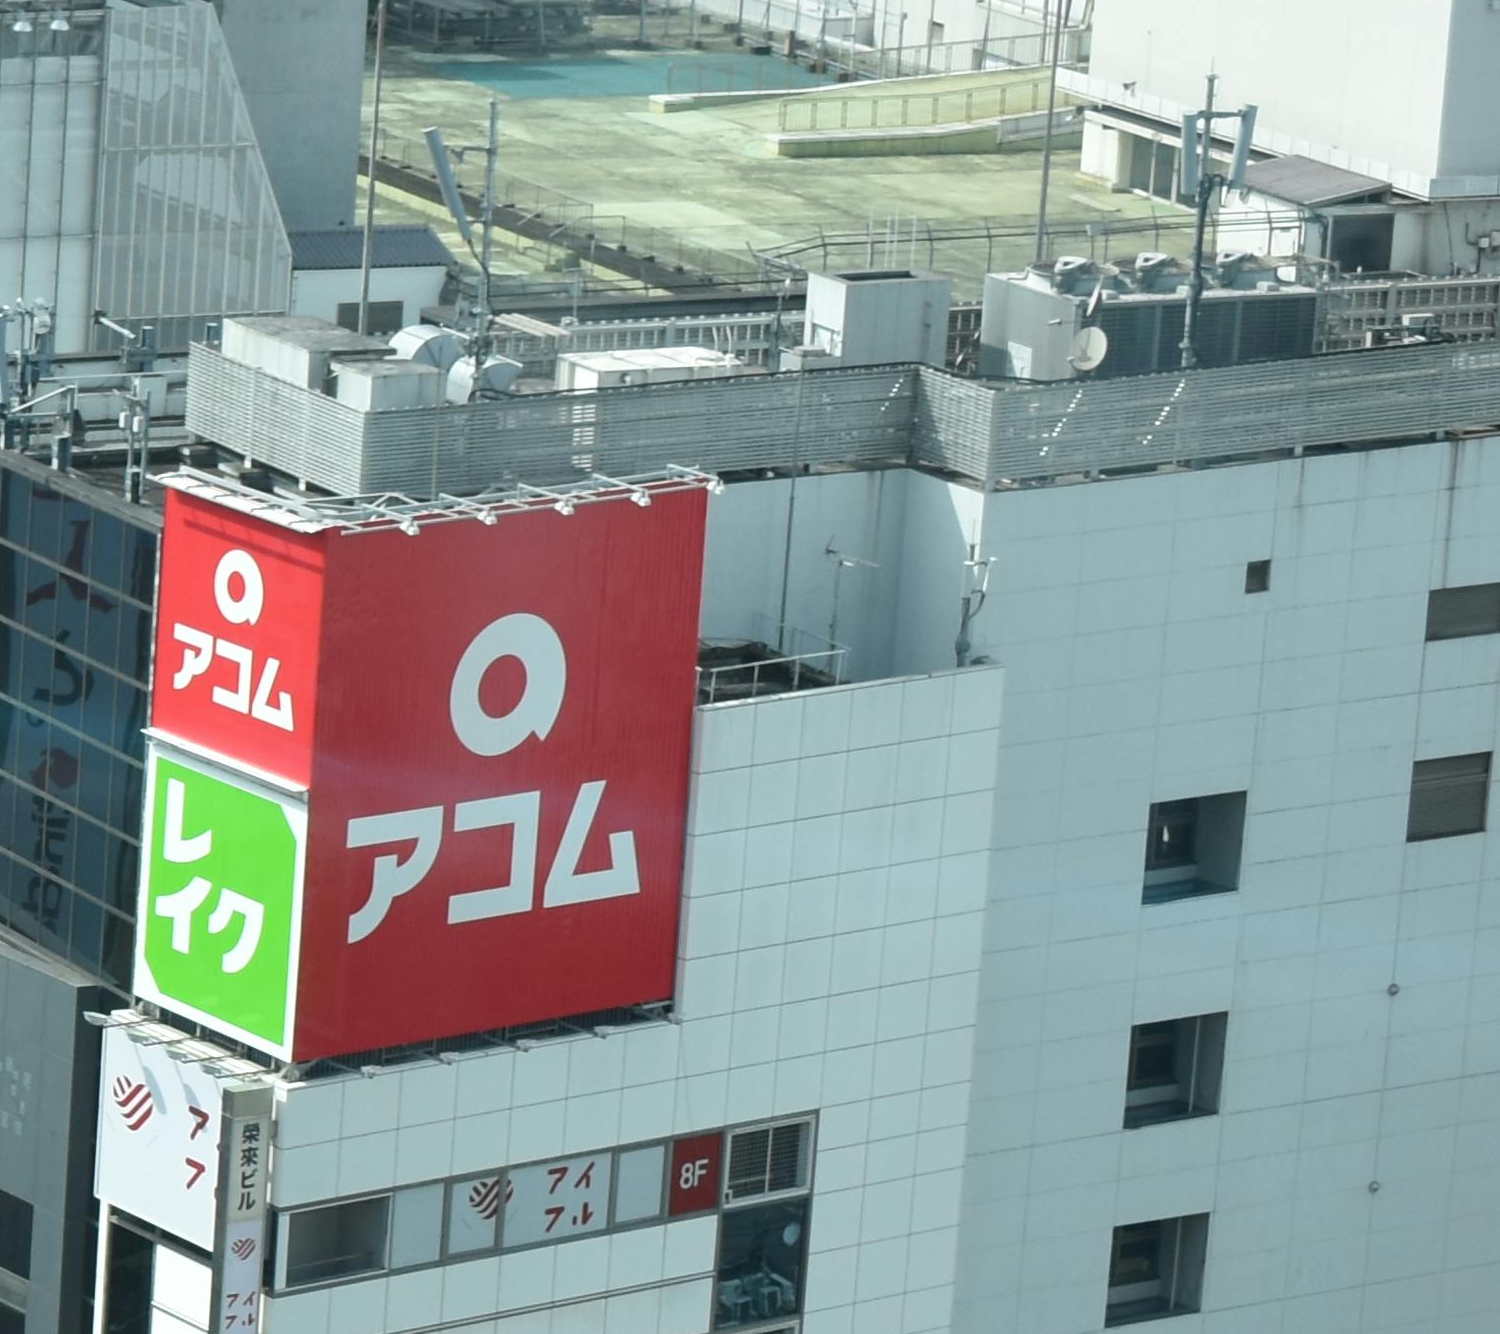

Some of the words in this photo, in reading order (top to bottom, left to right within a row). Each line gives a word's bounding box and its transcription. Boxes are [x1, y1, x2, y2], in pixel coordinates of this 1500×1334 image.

[171, 619, 296, 734] アコム
[152, 775, 268, 975] レイク
[345, 778, 642, 944] アコム
[678, 1158, 708, 1190] 8F
